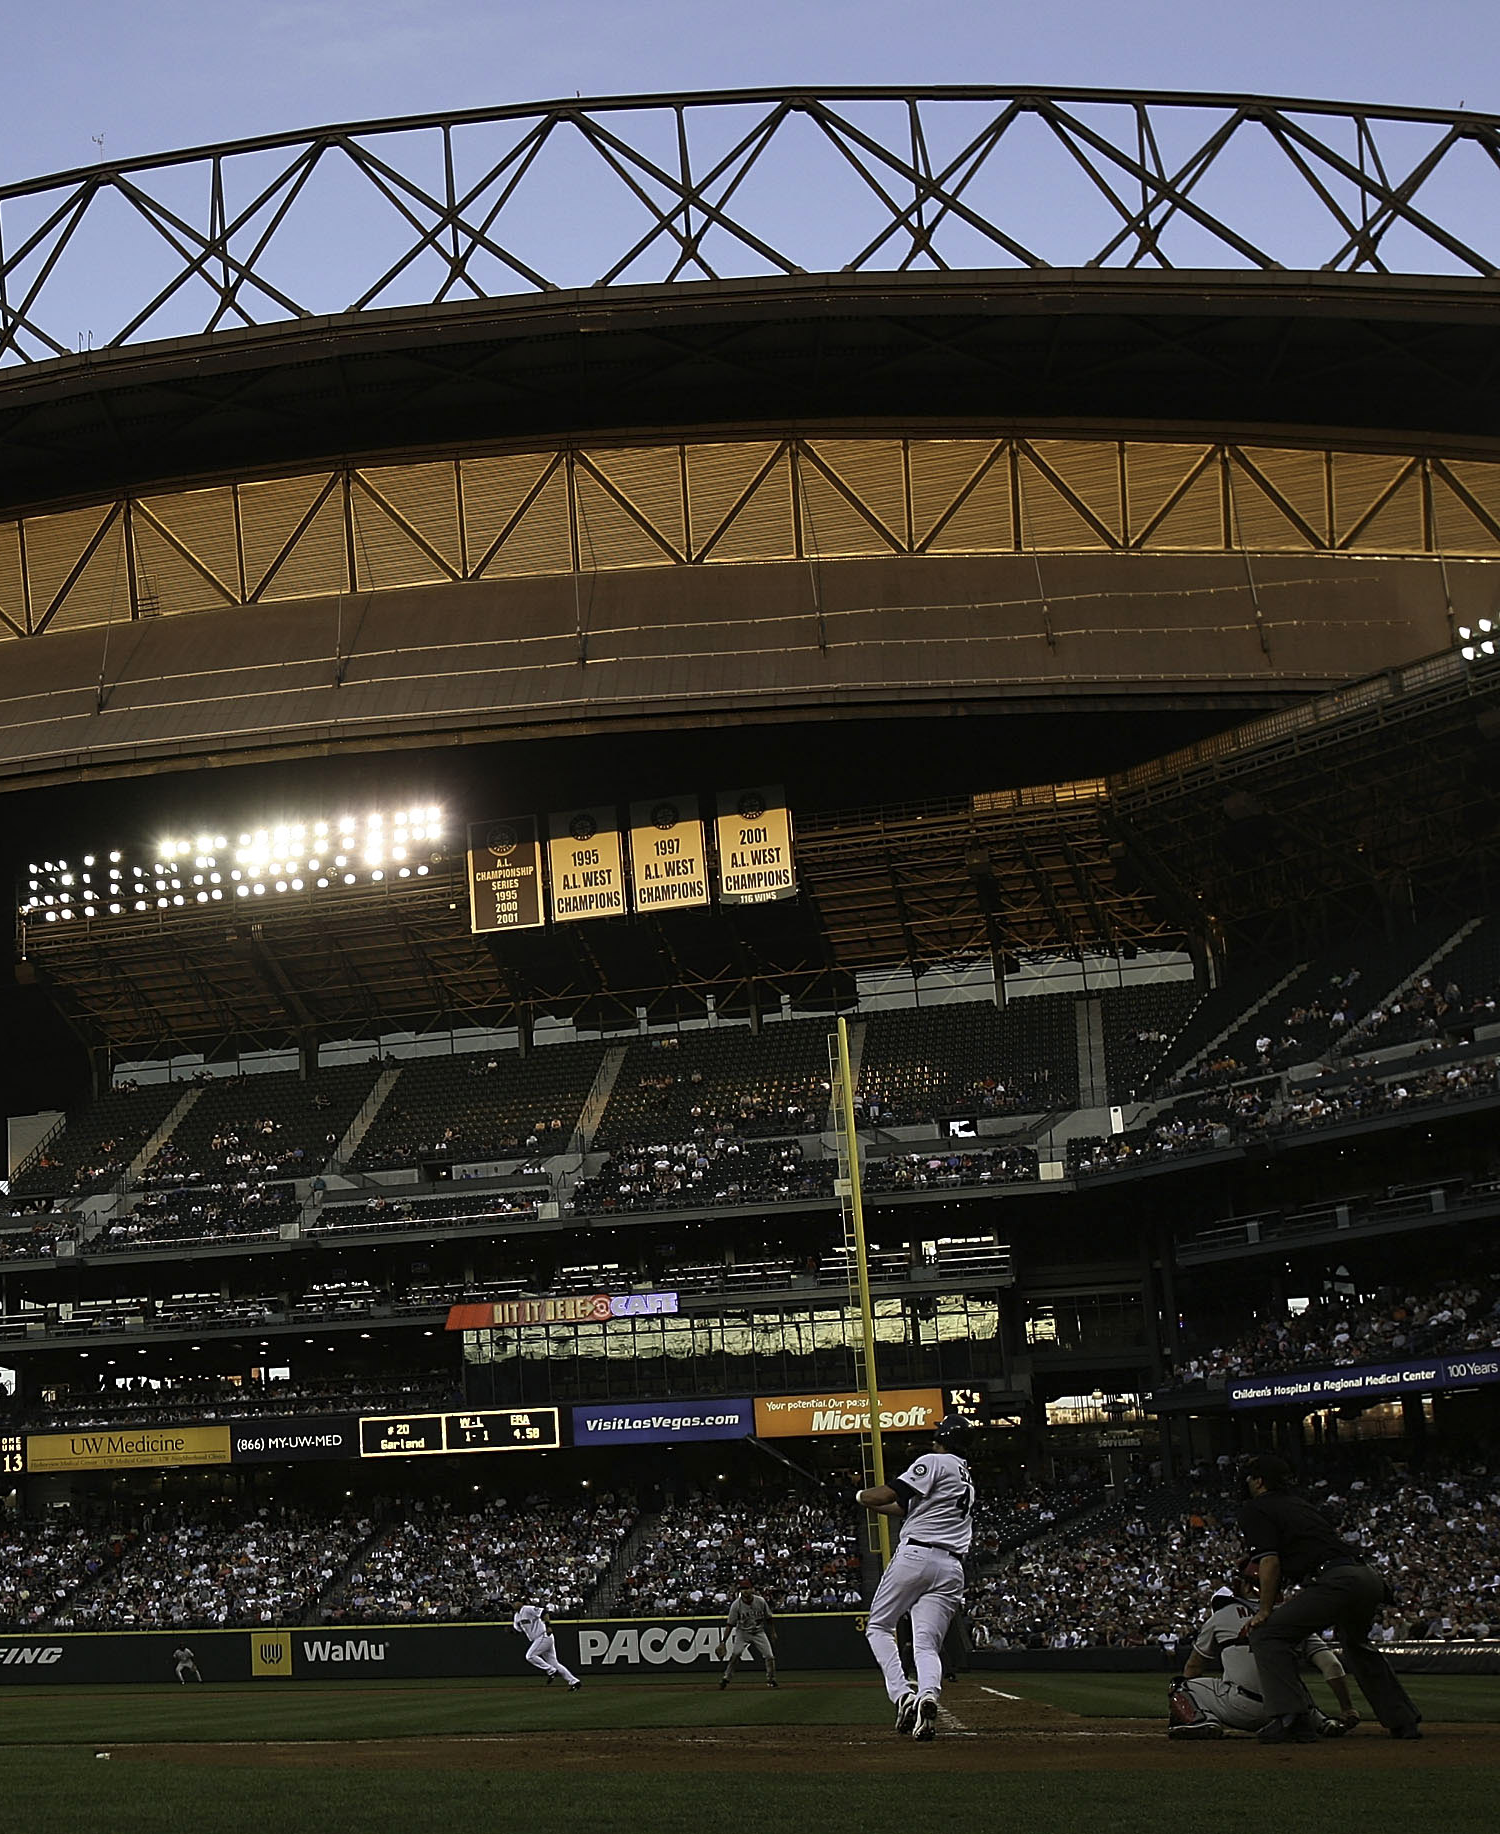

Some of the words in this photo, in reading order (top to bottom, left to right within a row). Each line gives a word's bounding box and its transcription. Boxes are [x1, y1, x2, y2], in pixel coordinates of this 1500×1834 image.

[739, 827, 768, 845] 2001
[654, 838, 680, 857] 1997
[496, 857, 512, 868] A.L.
[571, 849, 599, 867] 1995
[731, 852, 749, 869] A.L.
[751, 847, 781, 867] WEST
[476, 866, 534, 882] CHAMPIONSHIP
[644, 863, 663, 881] A.L.
[664, 858, 695, 878] WEST
[491, 879, 520, 891] SERIES
[563, 873, 581, 890] A.L.
[583, 869, 612, 888] WEST
[725, 869, 790, 891] CHAMPIONS
[495, 890, 518, 902] 1995
[639, 880, 704, 904] CHAMPIONS
[740, 894, 754, 904] 116
[754, 892, 777, 903] WINS
[495, 901, 518, 913] 2000
[557, 891, 621, 914] CHAMPIONS
[496, 912, 519, 925] 2001
[610, 1292, 678, 1316] CAFE
[1447, 1363, 1467, 1378] 100
[1466, 1362, 1499, 1375] Years
[1232, 1386, 1271, 1400] Children's
[1274, 1382, 1311, 1398] Hospital
[1313, 1381, 1322, 1391] &
[1323, 1377, 1363, 1393] Regional
[1365, 1372, 1400, 1387] Medical
[1402, 1369, 1436, 1382] Center
[765, 1401, 787, 1412] Your
[787, 1399, 828, 1412] potential.
[828, 1398, 845, 1409] Our
[586, 1412, 740, 1433] VisitLasVegas.com
[70, 1437, 105, 1455] UW
[107, 1434, 185, 1454] Medicine
[236, 1437, 265, 1452] (866)
[268, 1434, 343, 1450] MY-UW-MED
[381, 1437, 425, 1450] Garland
[3, 1453, 23, 1472] 13
[303, 1640, 386, 1662] WaMu
